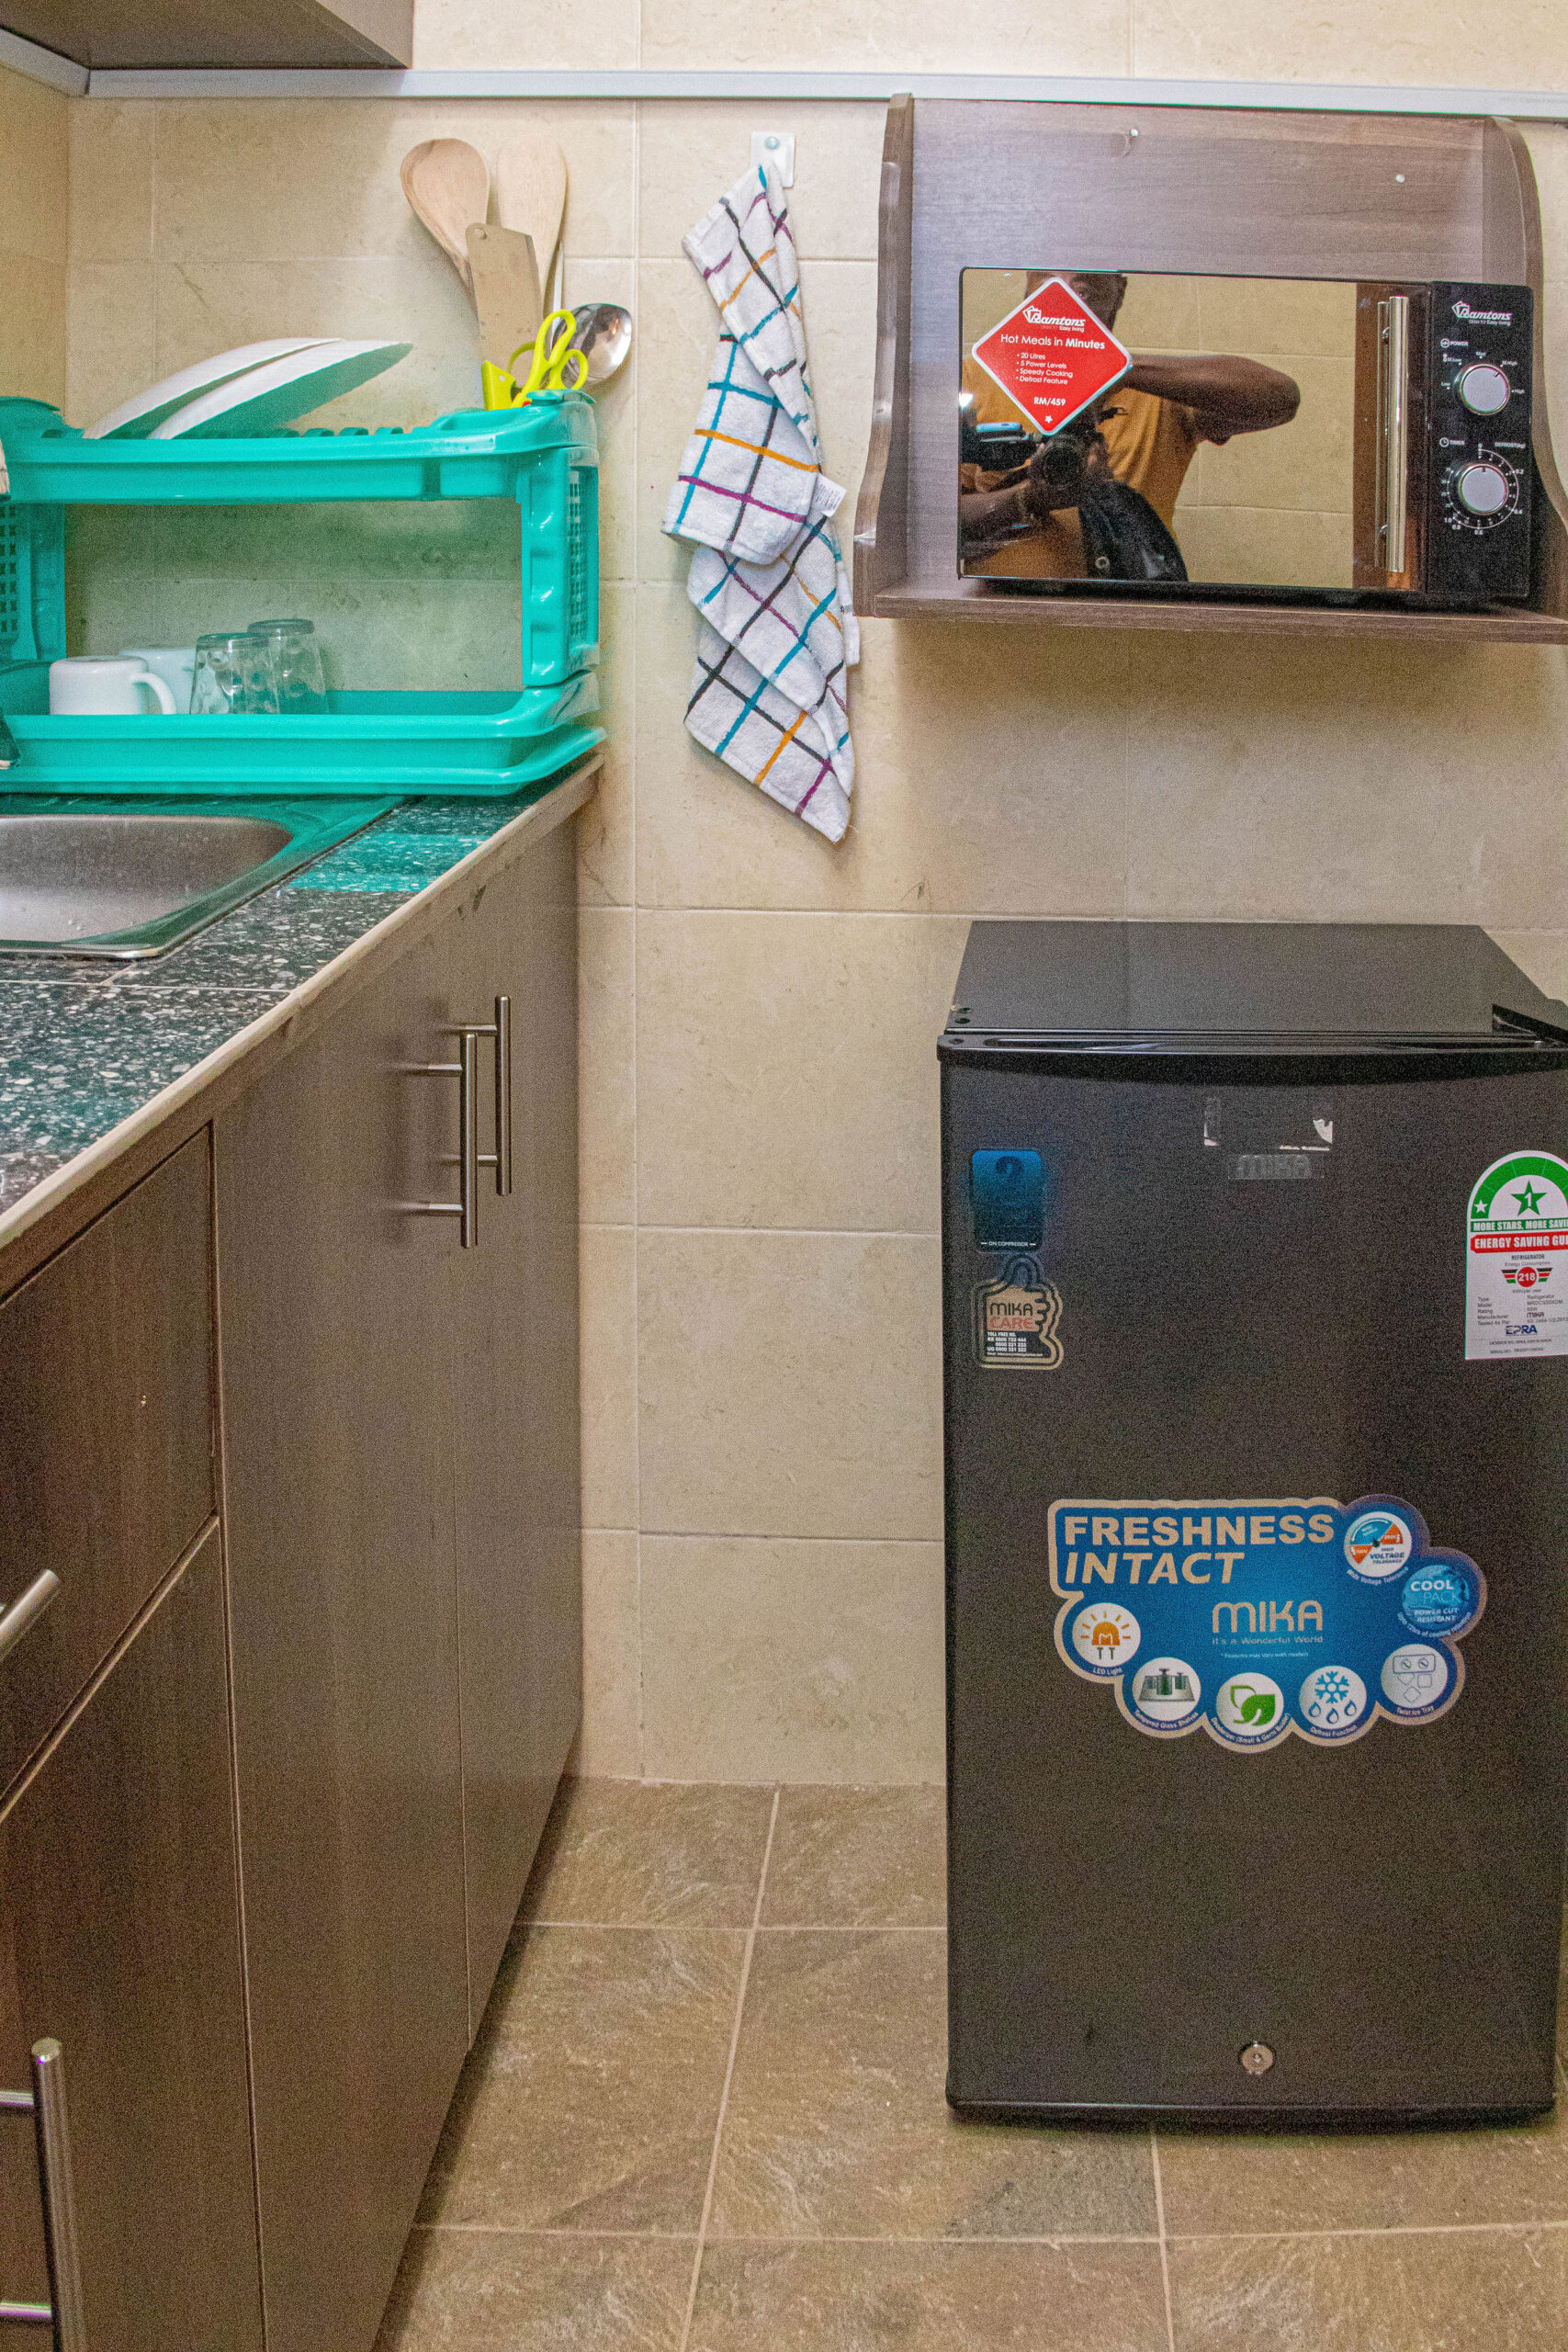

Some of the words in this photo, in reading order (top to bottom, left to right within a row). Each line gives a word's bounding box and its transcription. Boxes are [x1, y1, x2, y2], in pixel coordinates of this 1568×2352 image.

[1028, 310, 1086, 327] Ramtons
[1458, 308, 1512, 321] Ramtons
[1000, 334, 1020, 345] Hot
[1021, 335, 1052, 346] Meals
[1054, 336, 1064, 346] in
[1065, 337, 1106, 350] Minutes
[1020, 368, 1045, 377] Speedy
[1045, 369, 1074, 379] Cooking
[1043, 377, 1068, 385] Feature
[1033, 397, 1066, 406] RM/459
[1524, 1193, 1532, 1207] 1
[1472, 1222, 1496, 1231] MORE
[1525, 1220, 1548, 1229] MORE
[1474, 1237, 1512, 1250] ENERGY
[1513, 1236, 1550, 1248] SAVING
[1517, 1272, 1536, 1282] 218
[989, 1302, 1033, 1316] MIKA
[989, 1317, 1034, 1329] CARE
[1506, 1324, 1539, 1335] EPRA
[1065, 1514, 1335, 1546] FRESHNESS
[1370, 1552, 1405, 1560] VOLTAGE
[1065, 1552, 1246, 1585] INTACT
[1410, 1579, 1454, 1592] COOL
[1423, 1590, 1463, 1604] PACK
[1212, 1600, 1323, 1633] MIKA
[1416, 1615, 1456, 1623] RESISTANT
[1240, 1636, 1291, 1645] Wonderful
[1293, 1635, 1324, 1644] World
